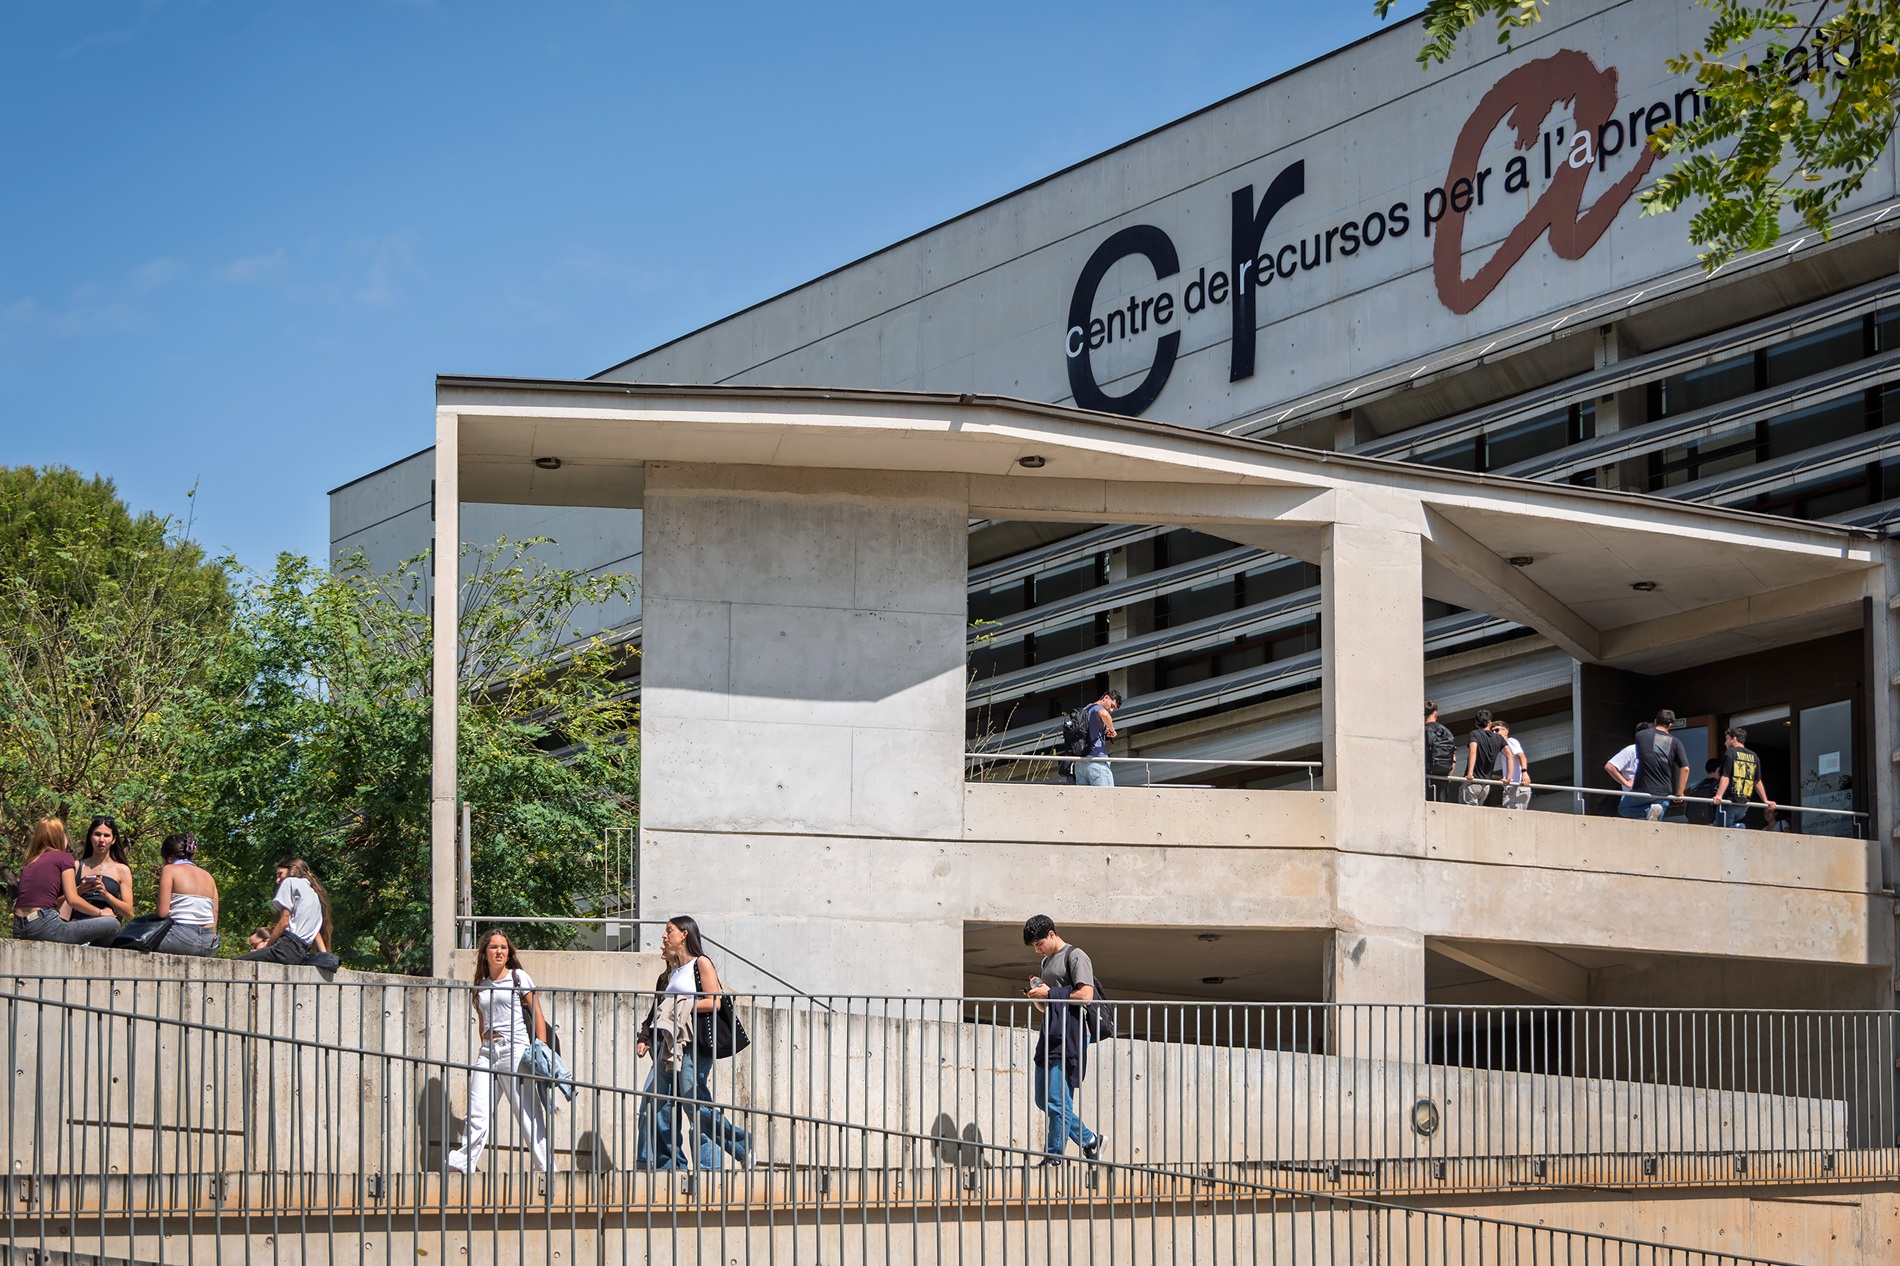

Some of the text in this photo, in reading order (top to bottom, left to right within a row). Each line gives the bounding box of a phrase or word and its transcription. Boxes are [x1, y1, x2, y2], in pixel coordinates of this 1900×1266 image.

[1065, 292, 1174, 358] centre
[1184, 267, 1229, 314] de
[1239, 202, 1410, 295] recursos
[1424, 166, 1492, 237] per
[1504, 155, 1530, 194] a
